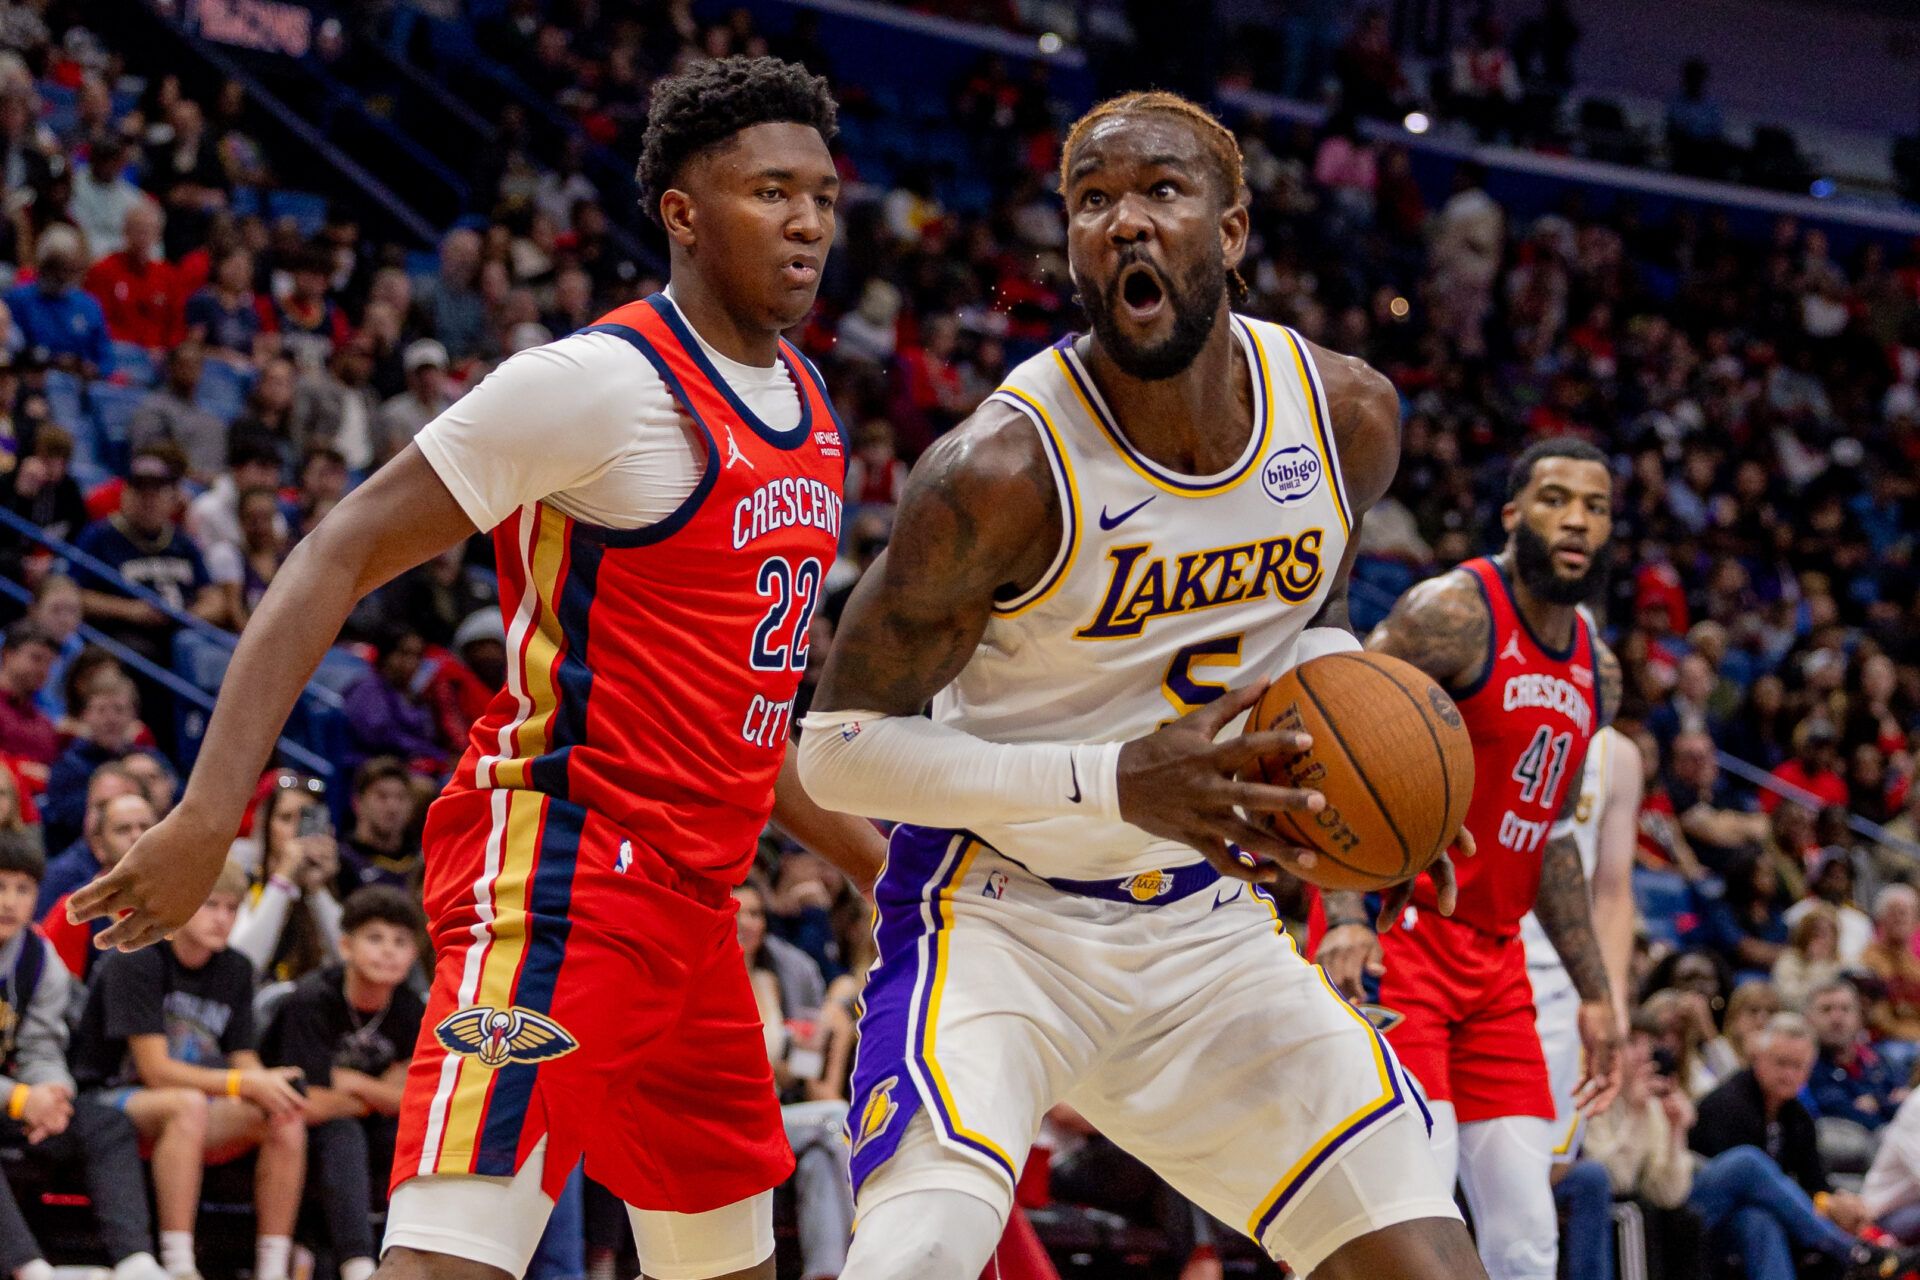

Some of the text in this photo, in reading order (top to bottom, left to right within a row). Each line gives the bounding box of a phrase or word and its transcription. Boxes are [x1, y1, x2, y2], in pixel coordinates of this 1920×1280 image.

[1267, 460, 1318, 485] bibigo
[750, 555, 822, 672] 22
[1071, 526, 1325, 642] LAKERS
[1503, 673, 1592, 739] CRESCENT
[1511, 724, 1574, 810] 41
[1498, 809, 1550, 853] CITY
